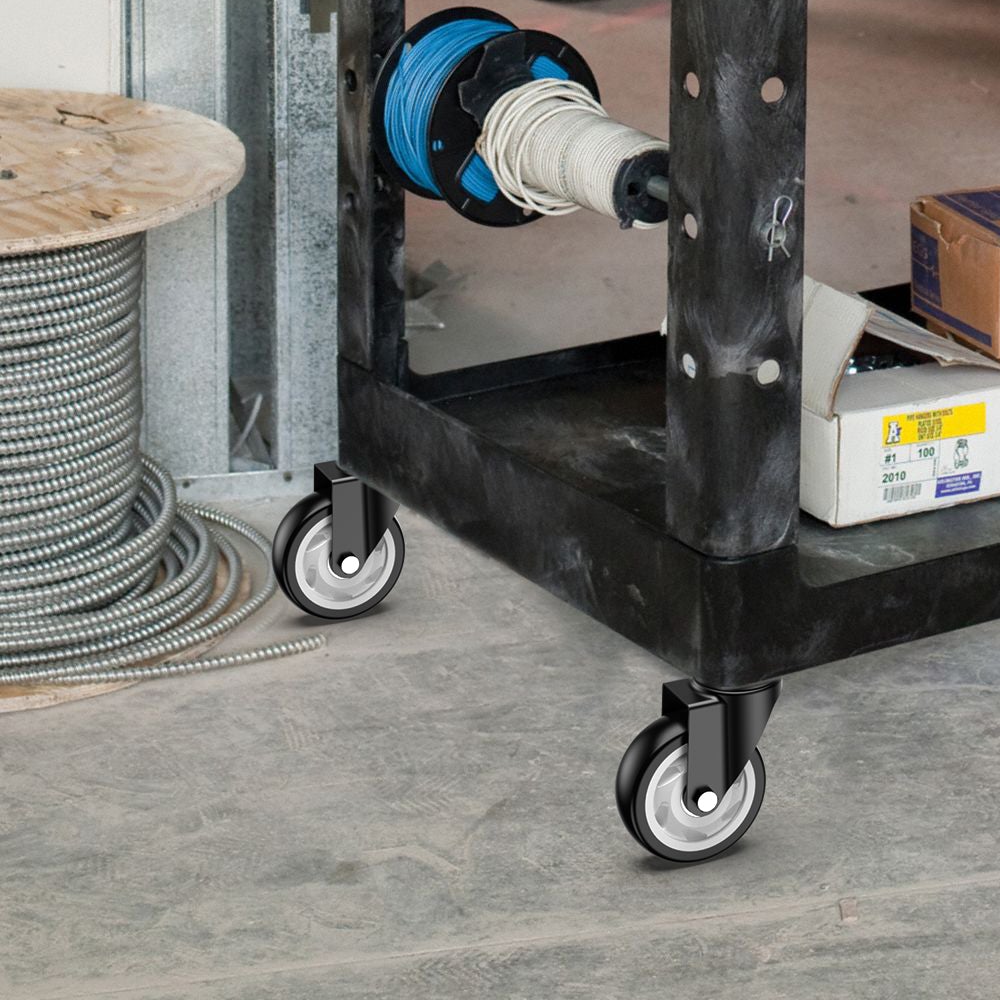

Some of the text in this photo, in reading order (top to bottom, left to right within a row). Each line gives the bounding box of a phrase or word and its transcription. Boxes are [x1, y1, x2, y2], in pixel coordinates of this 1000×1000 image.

[884, 453, 896, 463] #1
[918, 447, 935, 458] 100
[882, 471, 907, 484] 2010
